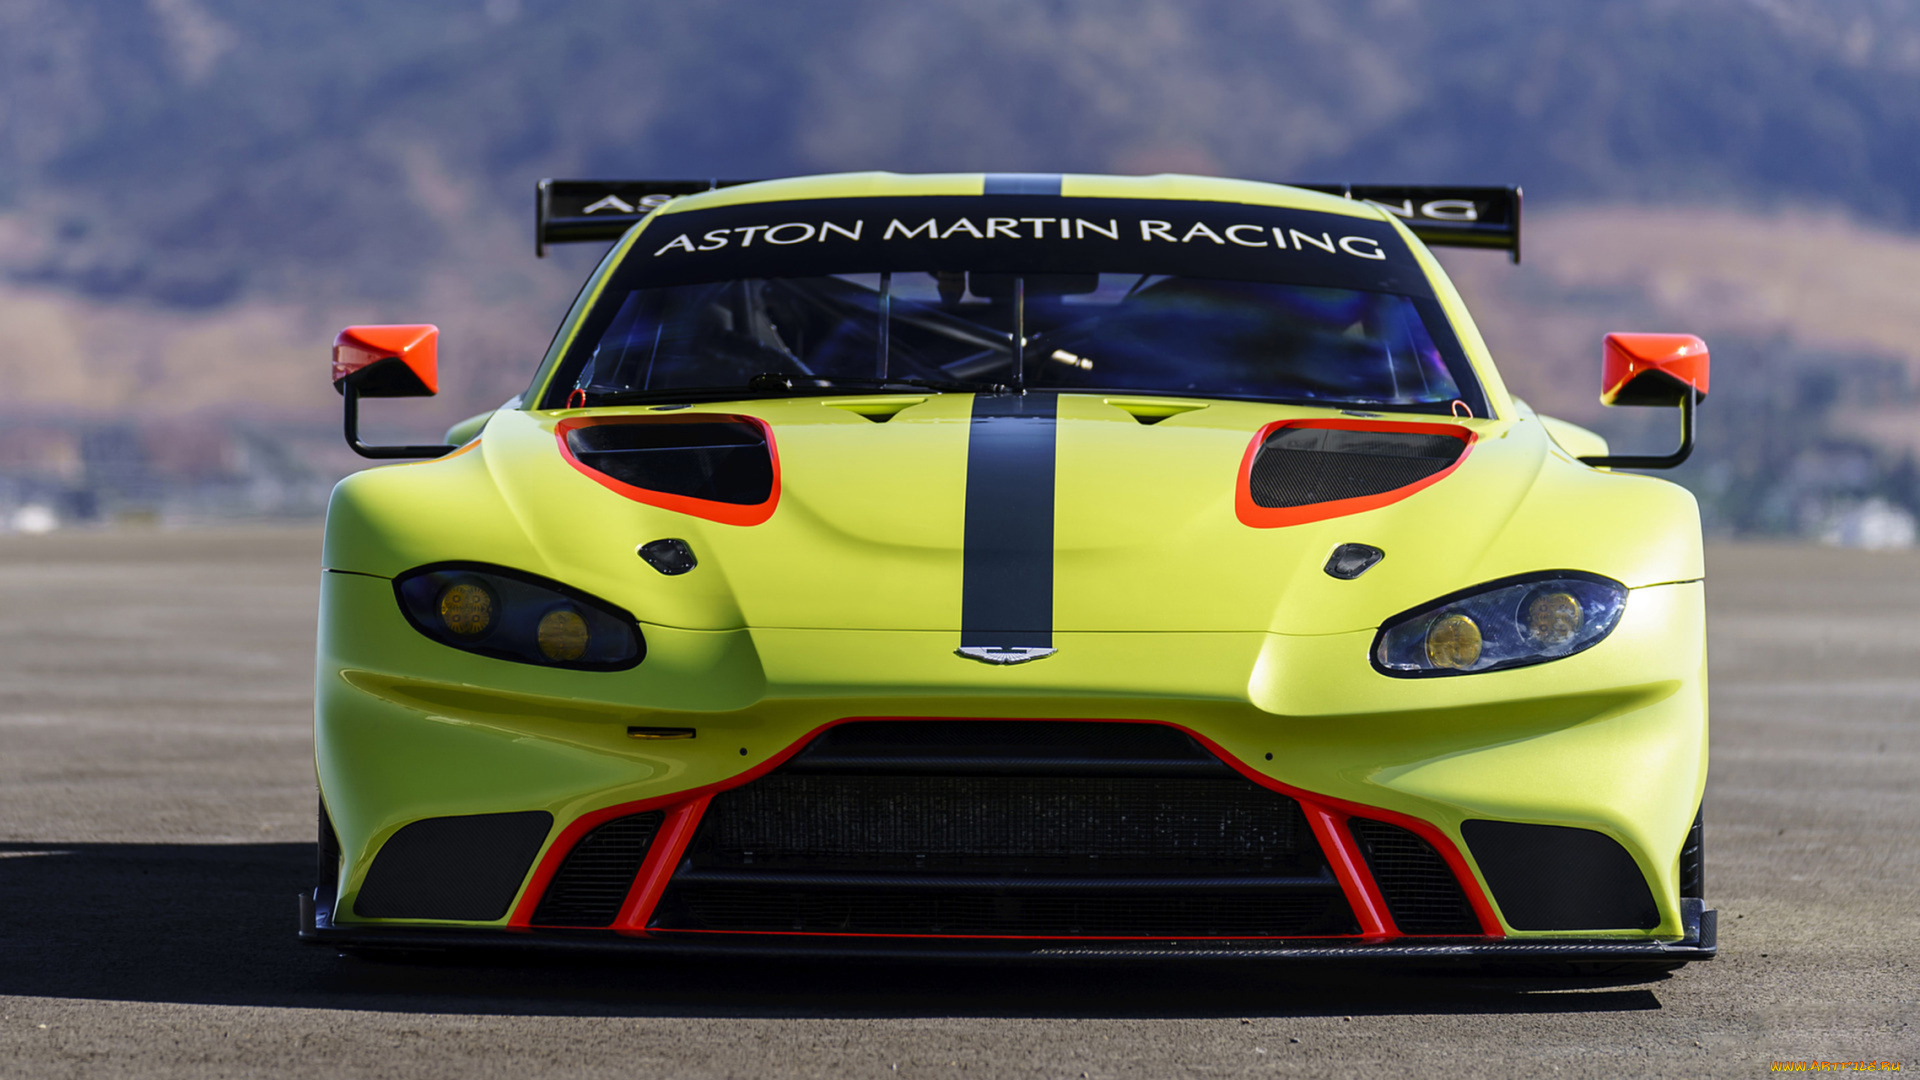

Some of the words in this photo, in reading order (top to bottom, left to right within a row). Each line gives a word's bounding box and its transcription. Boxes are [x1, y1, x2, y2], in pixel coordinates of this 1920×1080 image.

[653, 219, 864, 257] ASTON
[883, 217, 1119, 240] MARTIN
[1139, 219, 1386, 260] RACING
